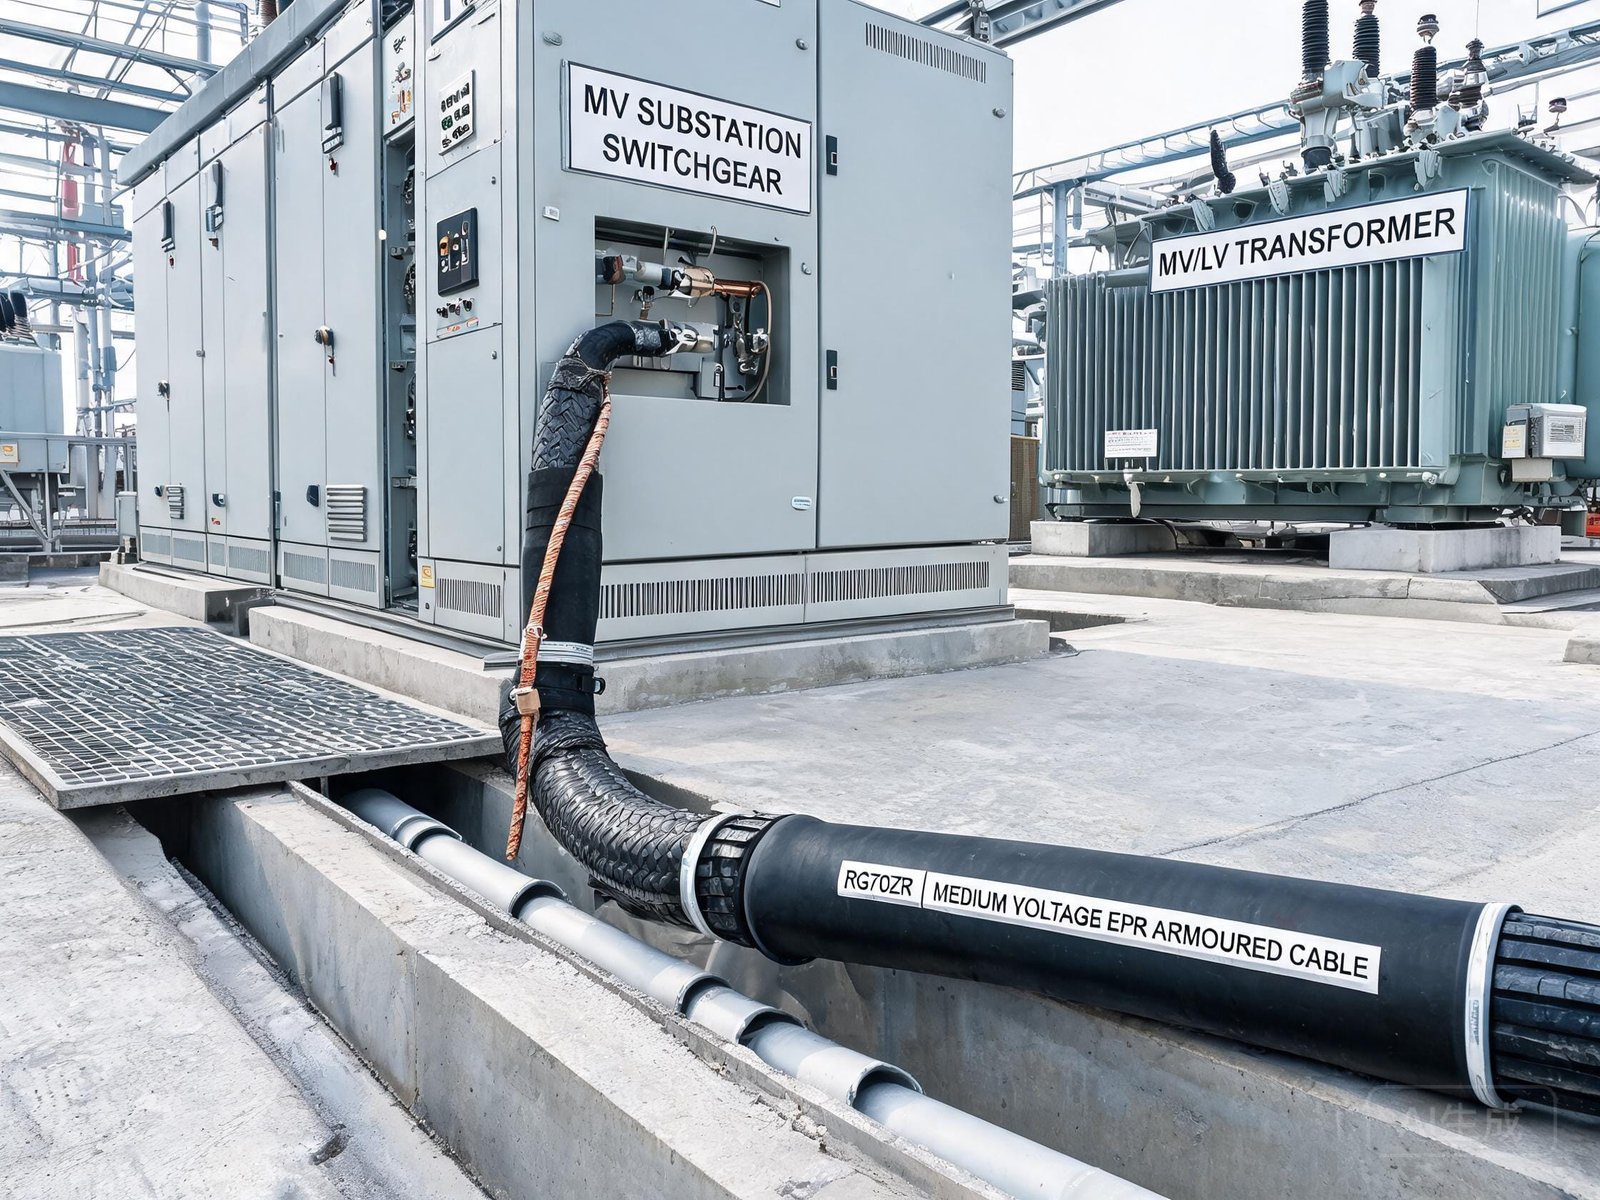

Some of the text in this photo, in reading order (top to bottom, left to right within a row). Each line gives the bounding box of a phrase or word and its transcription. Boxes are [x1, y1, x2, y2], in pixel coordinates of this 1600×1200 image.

[584, 84, 801, 159] MV SUBSTATION
[602, 133, 783, 195] SWITCHGEAR
[1159, 207, 1456, 277] MV/LV TRANSFORMER
[933, 882, 1007, 914] MEDIUM
[1107, 911, 1147, 937] EPR
[1152, 920, 1282, 961] ARMOURED
[1290, 944, 1368, 979] CABLE
